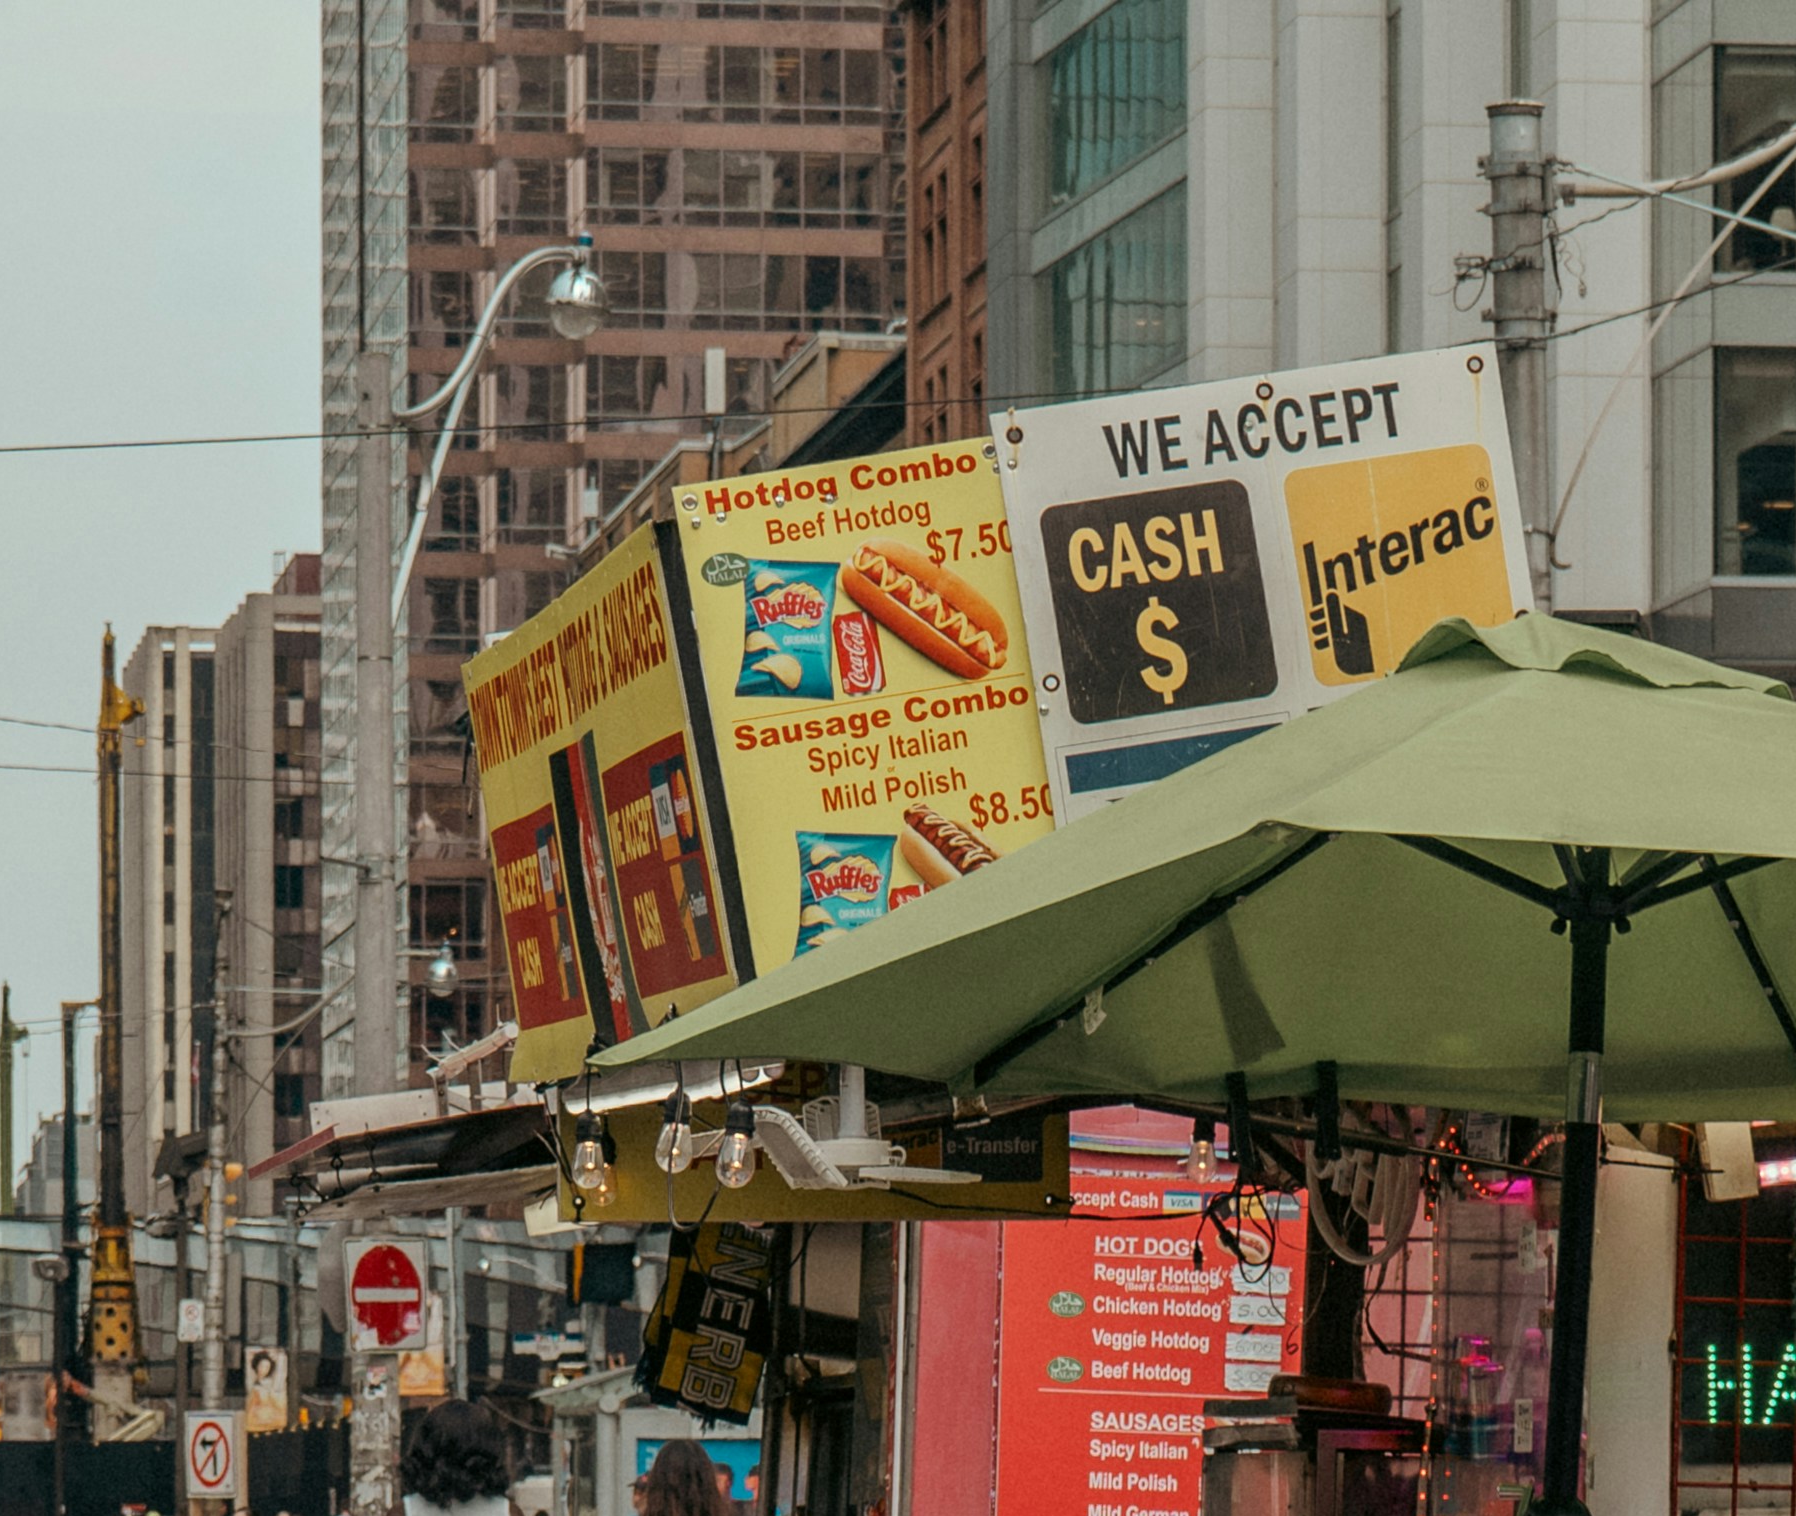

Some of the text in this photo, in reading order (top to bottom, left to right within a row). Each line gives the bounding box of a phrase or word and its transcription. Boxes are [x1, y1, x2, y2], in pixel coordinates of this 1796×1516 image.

[1102, 382, 1400, 478] WE ACCEPT
[705, 453, 977, 515] Hotdog Combo
[766, 501, 931, 545] Beef Hotdog
[926, 520, 1012, 568] $7.50
[1067, 508, 1225, 593] CASH
[1302, 494, 1495, 606] Interac
[752, 591, 826, 624] Ruffles
[530, 561, 667, 740] BEST SAUSAGES
[1135, 595, 1189, 705] $
[734, 685, 1029, 750] Sausage Combo
[807, 728, 968, 776] Spicy Italian
[821, 767, 967, 813] Mild Polish
[969, 782, 1055, 831] $8.50
[622, 795, 658, 864] ACCEPT
[806, 865, 883, 901] Ruffles
[633, 890, 664, 951] CASH
[517, 937, 544, 989] CASH
[946, 1136, 1039, 1155] e-Transfer
[1119, 1191, 1158, 1208] Cash
[1095, 1236, 1138, 1254] HOT
[1094, 1264, 1221, 1288] Regular Hotdog
[1093, 1296, 1222, 1321] Chicken Hotdog
[1092, 1328, 1210, 1354] Veggie Hotdog
[1091, 1361, 1192, 1385] Beef Hotdog
[1090, 1411, 1205, 1432] SAUSAGES
[1090, 1439, 1188, 1462] Spicy Italian
[1089, 1472, 1178, 1492] Mild Polish
